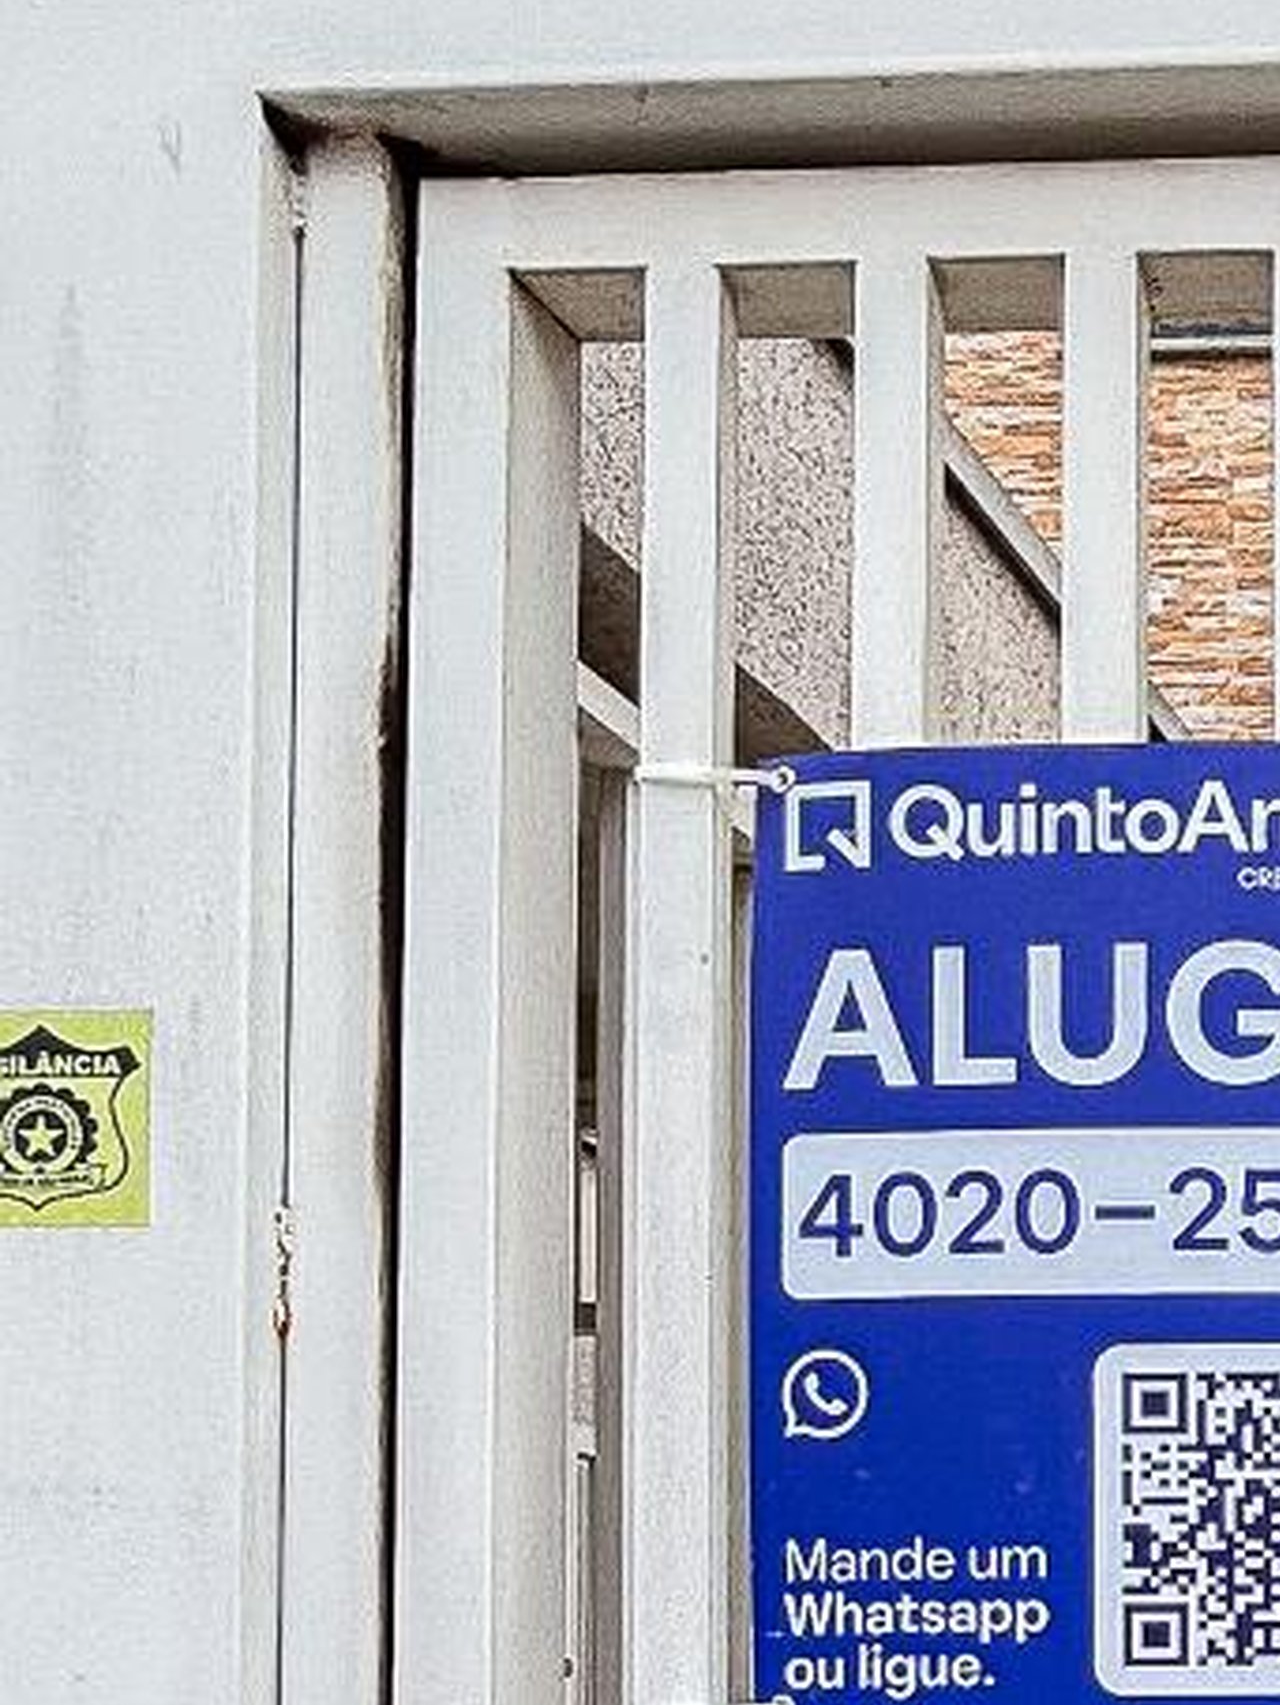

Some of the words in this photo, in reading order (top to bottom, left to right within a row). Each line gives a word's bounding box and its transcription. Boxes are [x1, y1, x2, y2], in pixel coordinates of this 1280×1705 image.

[785, 1535, 958, 1583] Mande
[967, 1543, 1048, 1581] um
[784, 1591, 1050, 1644] Whatsapp
[783, 1654, 848, 1691] ou
[857, 1645, 996, 1700] ligue.
